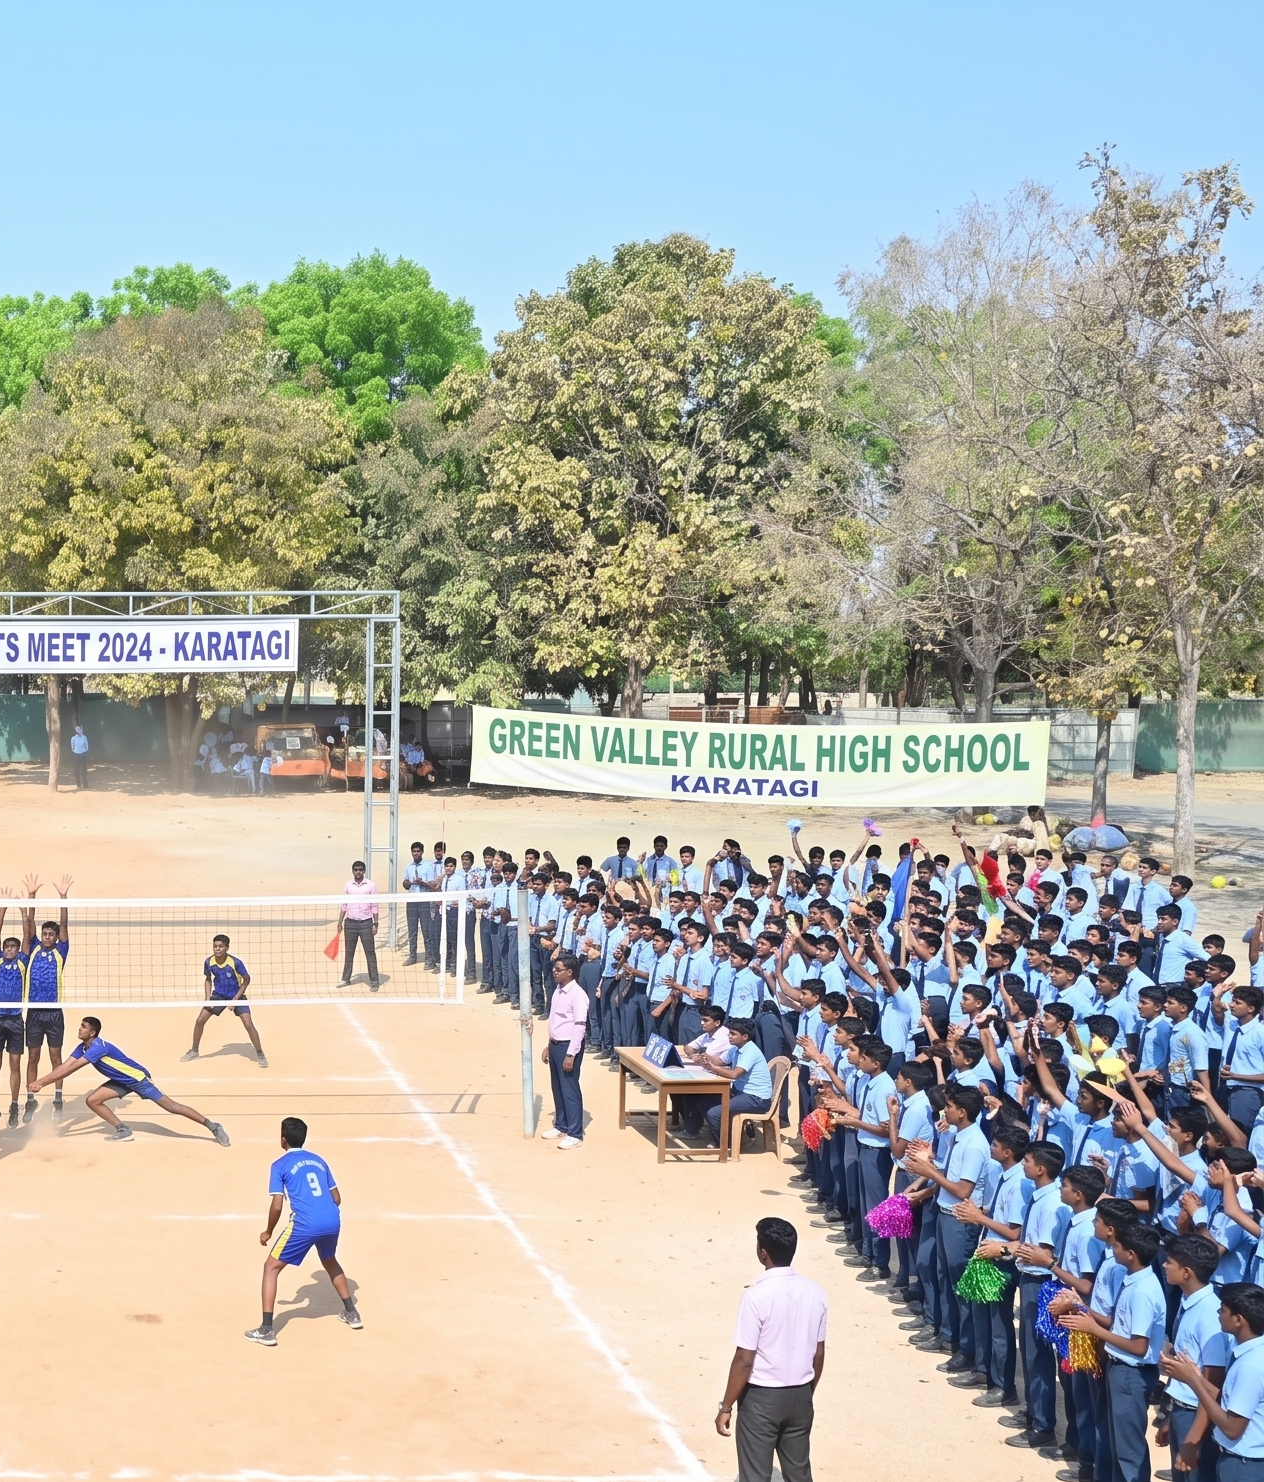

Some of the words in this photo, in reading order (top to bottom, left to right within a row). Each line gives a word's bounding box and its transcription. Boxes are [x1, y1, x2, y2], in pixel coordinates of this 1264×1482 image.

[28, 633, 90, 662] MEET
[99, 633, 152, 662] 2024
[175, 630, 289, 660] KARATAGI
[490, 719, 580, 759] GREEN
[592, 727, 697, 766] VALLEY
[709, 733, 804, 770] RURAL
[817, 736, 891, 772] HIGH
[903, 734, 1029, 772] SCHOOL
[672, 775, 818, 797] KARATAGI
[306, 1172, 322, 1197] 9
